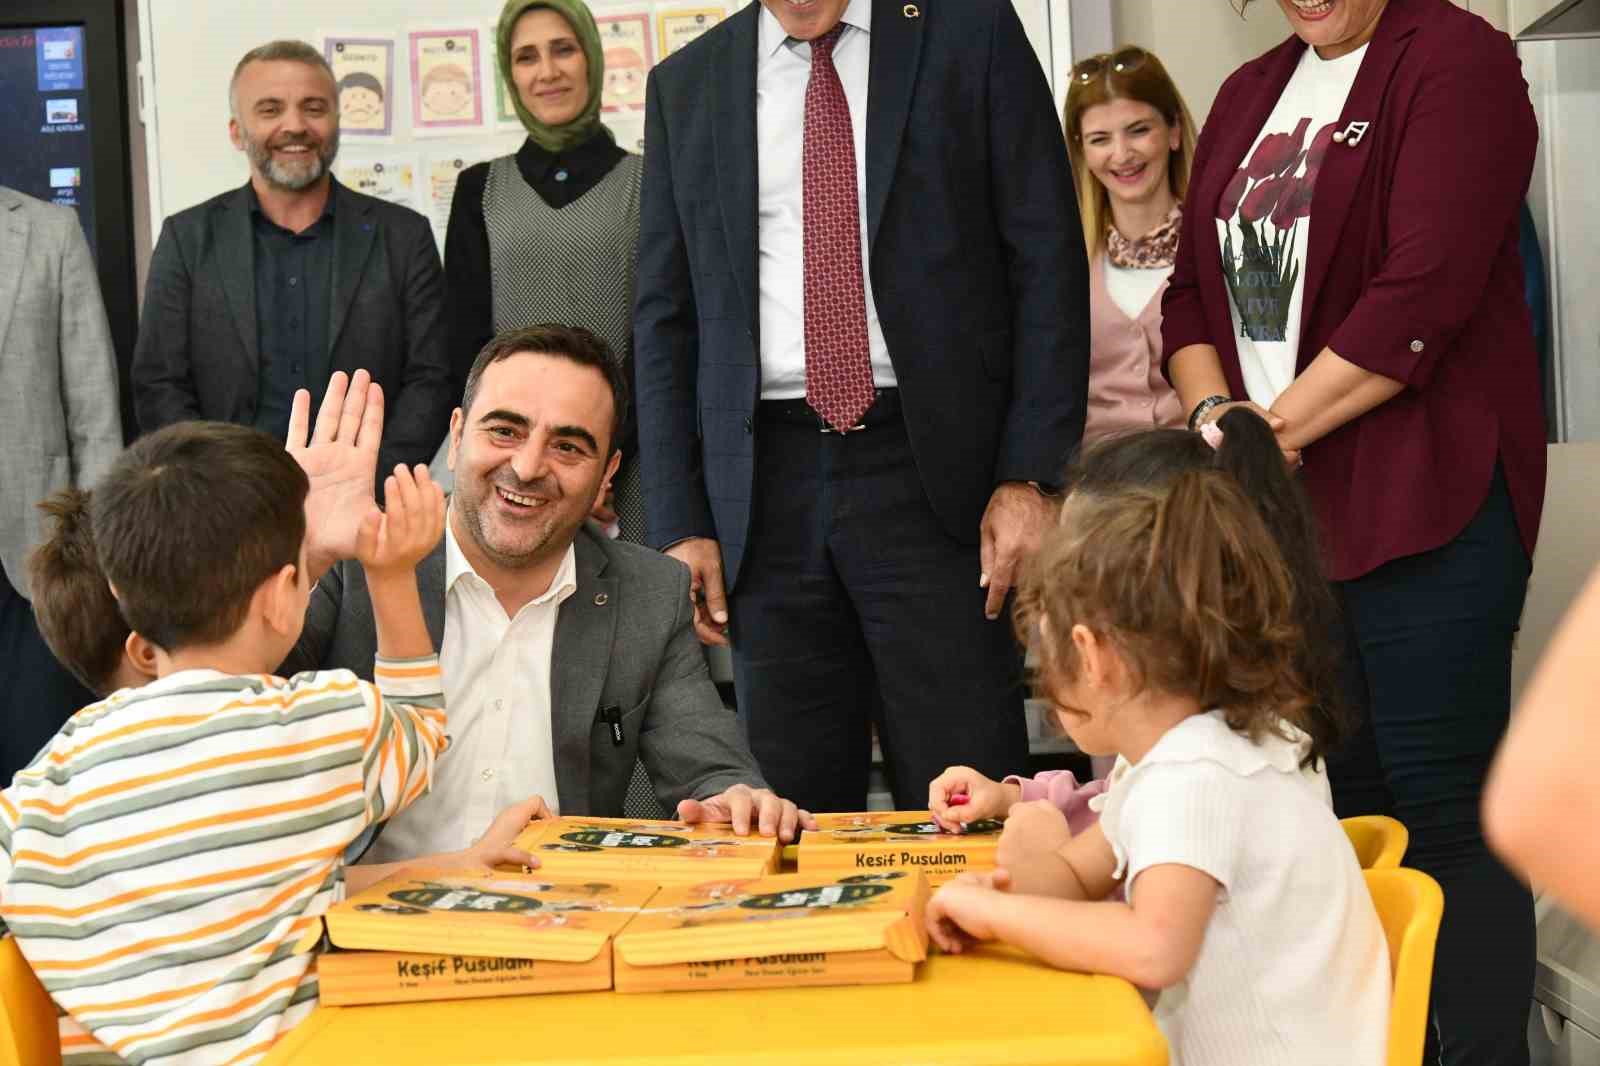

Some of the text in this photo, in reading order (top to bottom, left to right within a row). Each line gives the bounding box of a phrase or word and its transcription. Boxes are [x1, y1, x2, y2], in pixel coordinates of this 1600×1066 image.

[900, 850, 967, 866] Pusulam
[397, 959, 447, 980] Keşif
[452, 955, 534, 974] Pusulam
